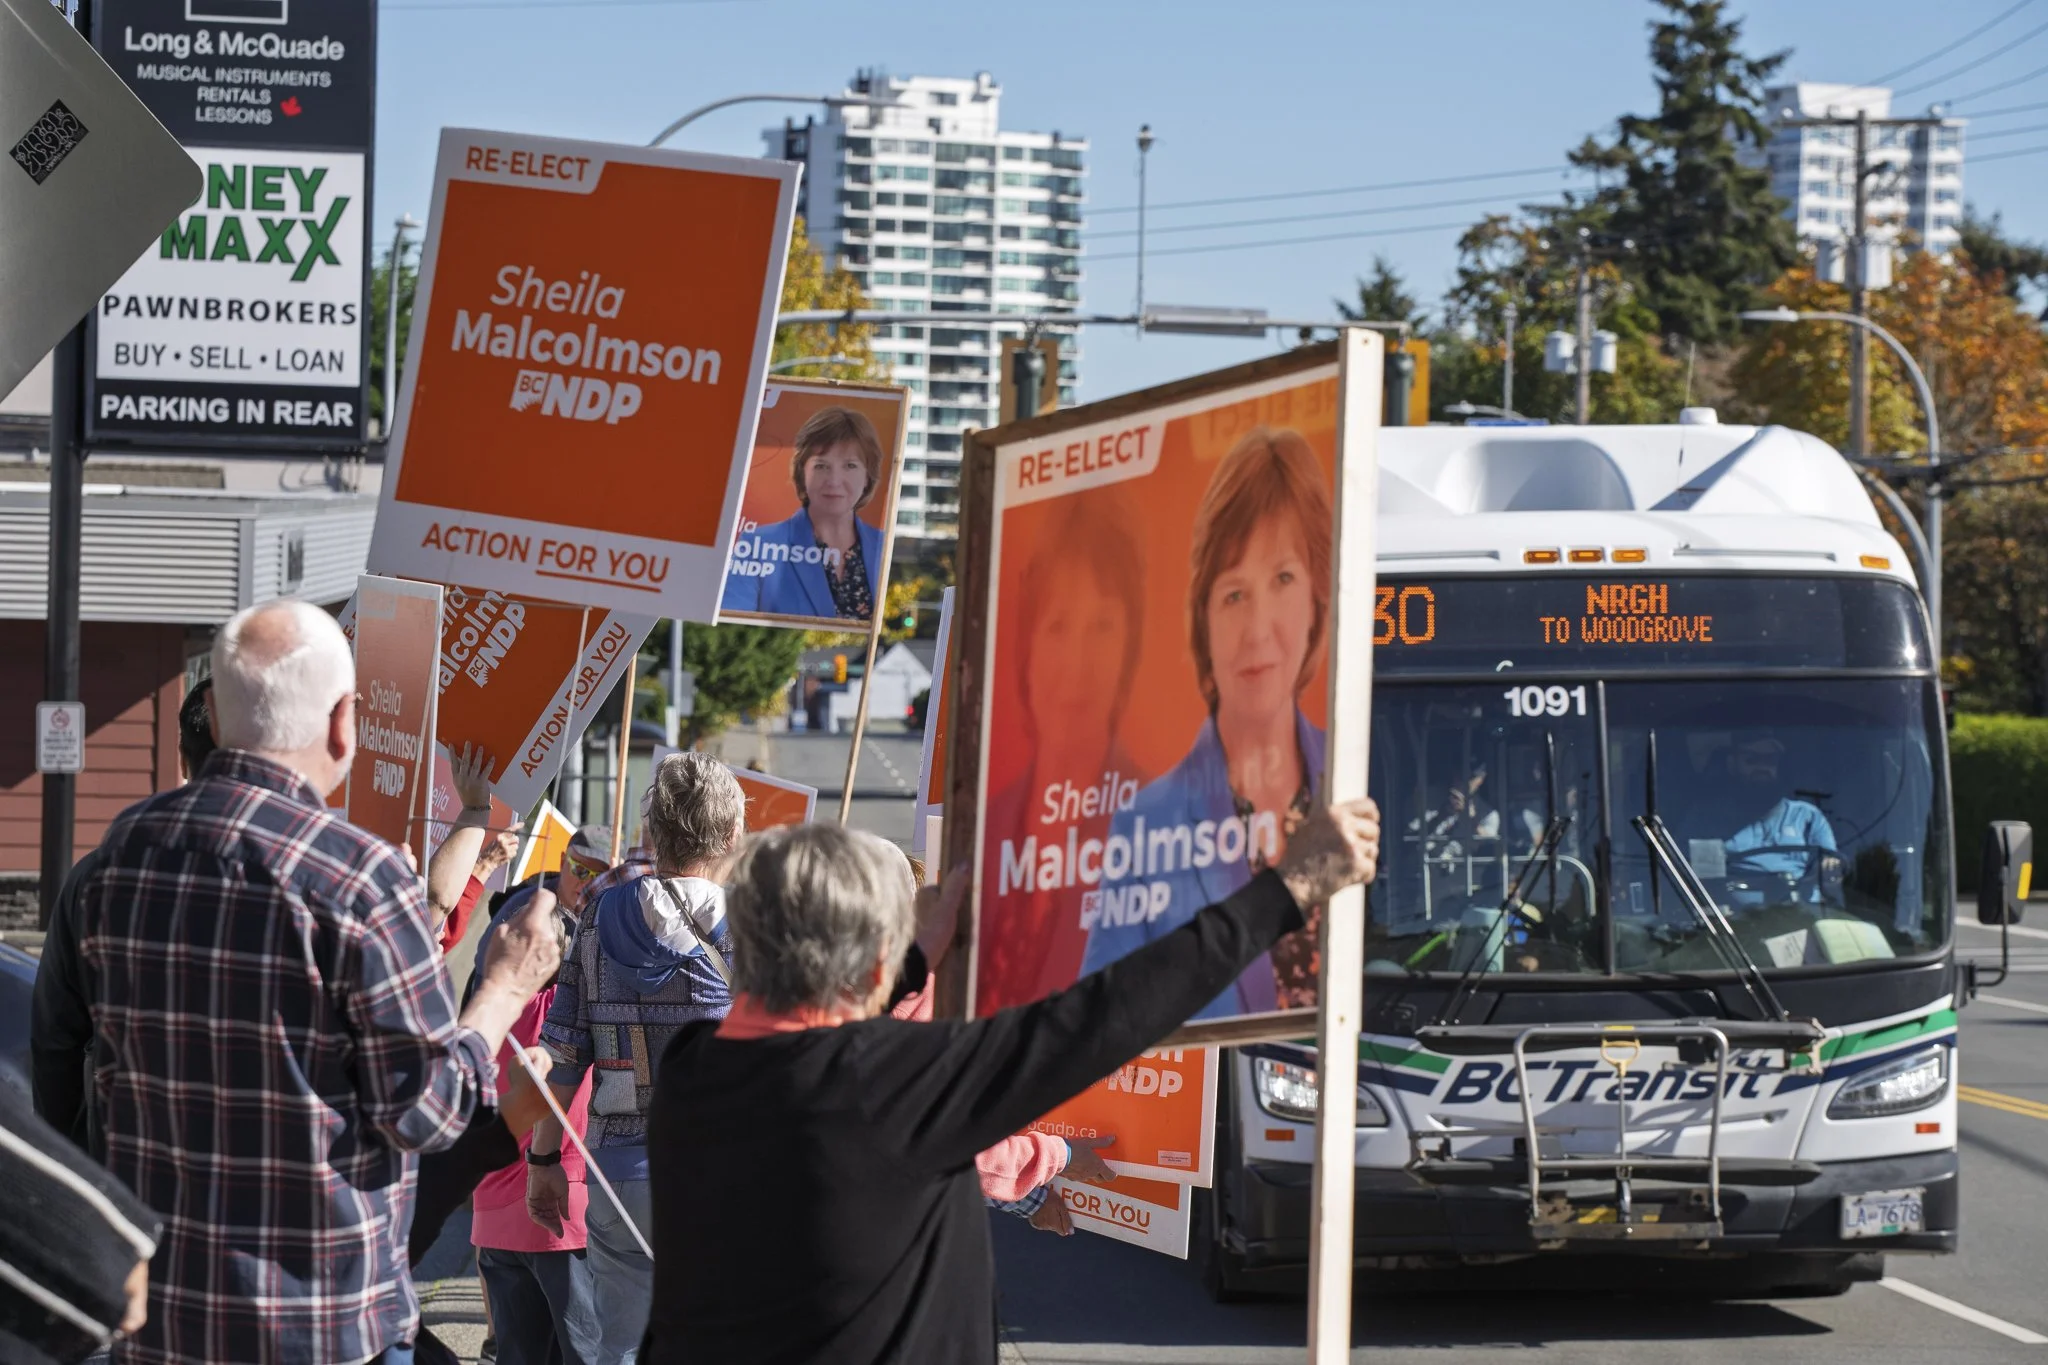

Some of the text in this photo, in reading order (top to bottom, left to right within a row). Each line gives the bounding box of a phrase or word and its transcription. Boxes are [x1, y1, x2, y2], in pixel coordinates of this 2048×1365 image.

[124, 26, 345, 60] Long & McQuade
[137, 64, 332, 88] MUSICAL INSTRUMENTS
[197, 87, 272, 105] RENTALS
[195, 107, 273, 125] LESSONS
[465, 145, 591, 182] RE-ELECT
[207, 164, 329, 212] NEY
[160, 197, 351, 282] MAXX
[103, 295, 357, 325] PAWNBROKERS
[489, 265, 625, 319] Sheila
[114, 343, 344, 373] BUY SELL LOAN
[451, 309, 722, 385] Malcolmson
[101, 394, 354, 427] PARKING IN REAR
[540, 377, 643, 424] NDP
[1018, 425, 1152, 489] RE-ELECT
[421, 522, 671, 584] ACTION FOR YOU
[732, 561, 776, 578] NDP
[733, 535, 841, 567] olmson
[1372, 586, 1435, 645] 30
[1586, 583, 1670, 615] NRGH
[438, 590, 509, 695] alcolm
[484, 602, 526, 671] NDP
[1540, 615, 1714, 643] TO WOODGROVE
[368, 679, 403, 717] Sheila
[520, 621, 627, 779] ACTION FOR YOU
[1503, 685, 1587, 717] 1091
[358, 715, 422, 762] Malcolmso
[380, 762, 406, 799] NDP
[1041, 772, 1138, 825] Sheila
[999, 810, 1278, 896] Malcolmson
[1100, 881, 1172, 929] NDP
[1107, 1064, 1184, 1098] NDP
[1061, 1187, 1151, 1228] FOR YOU
